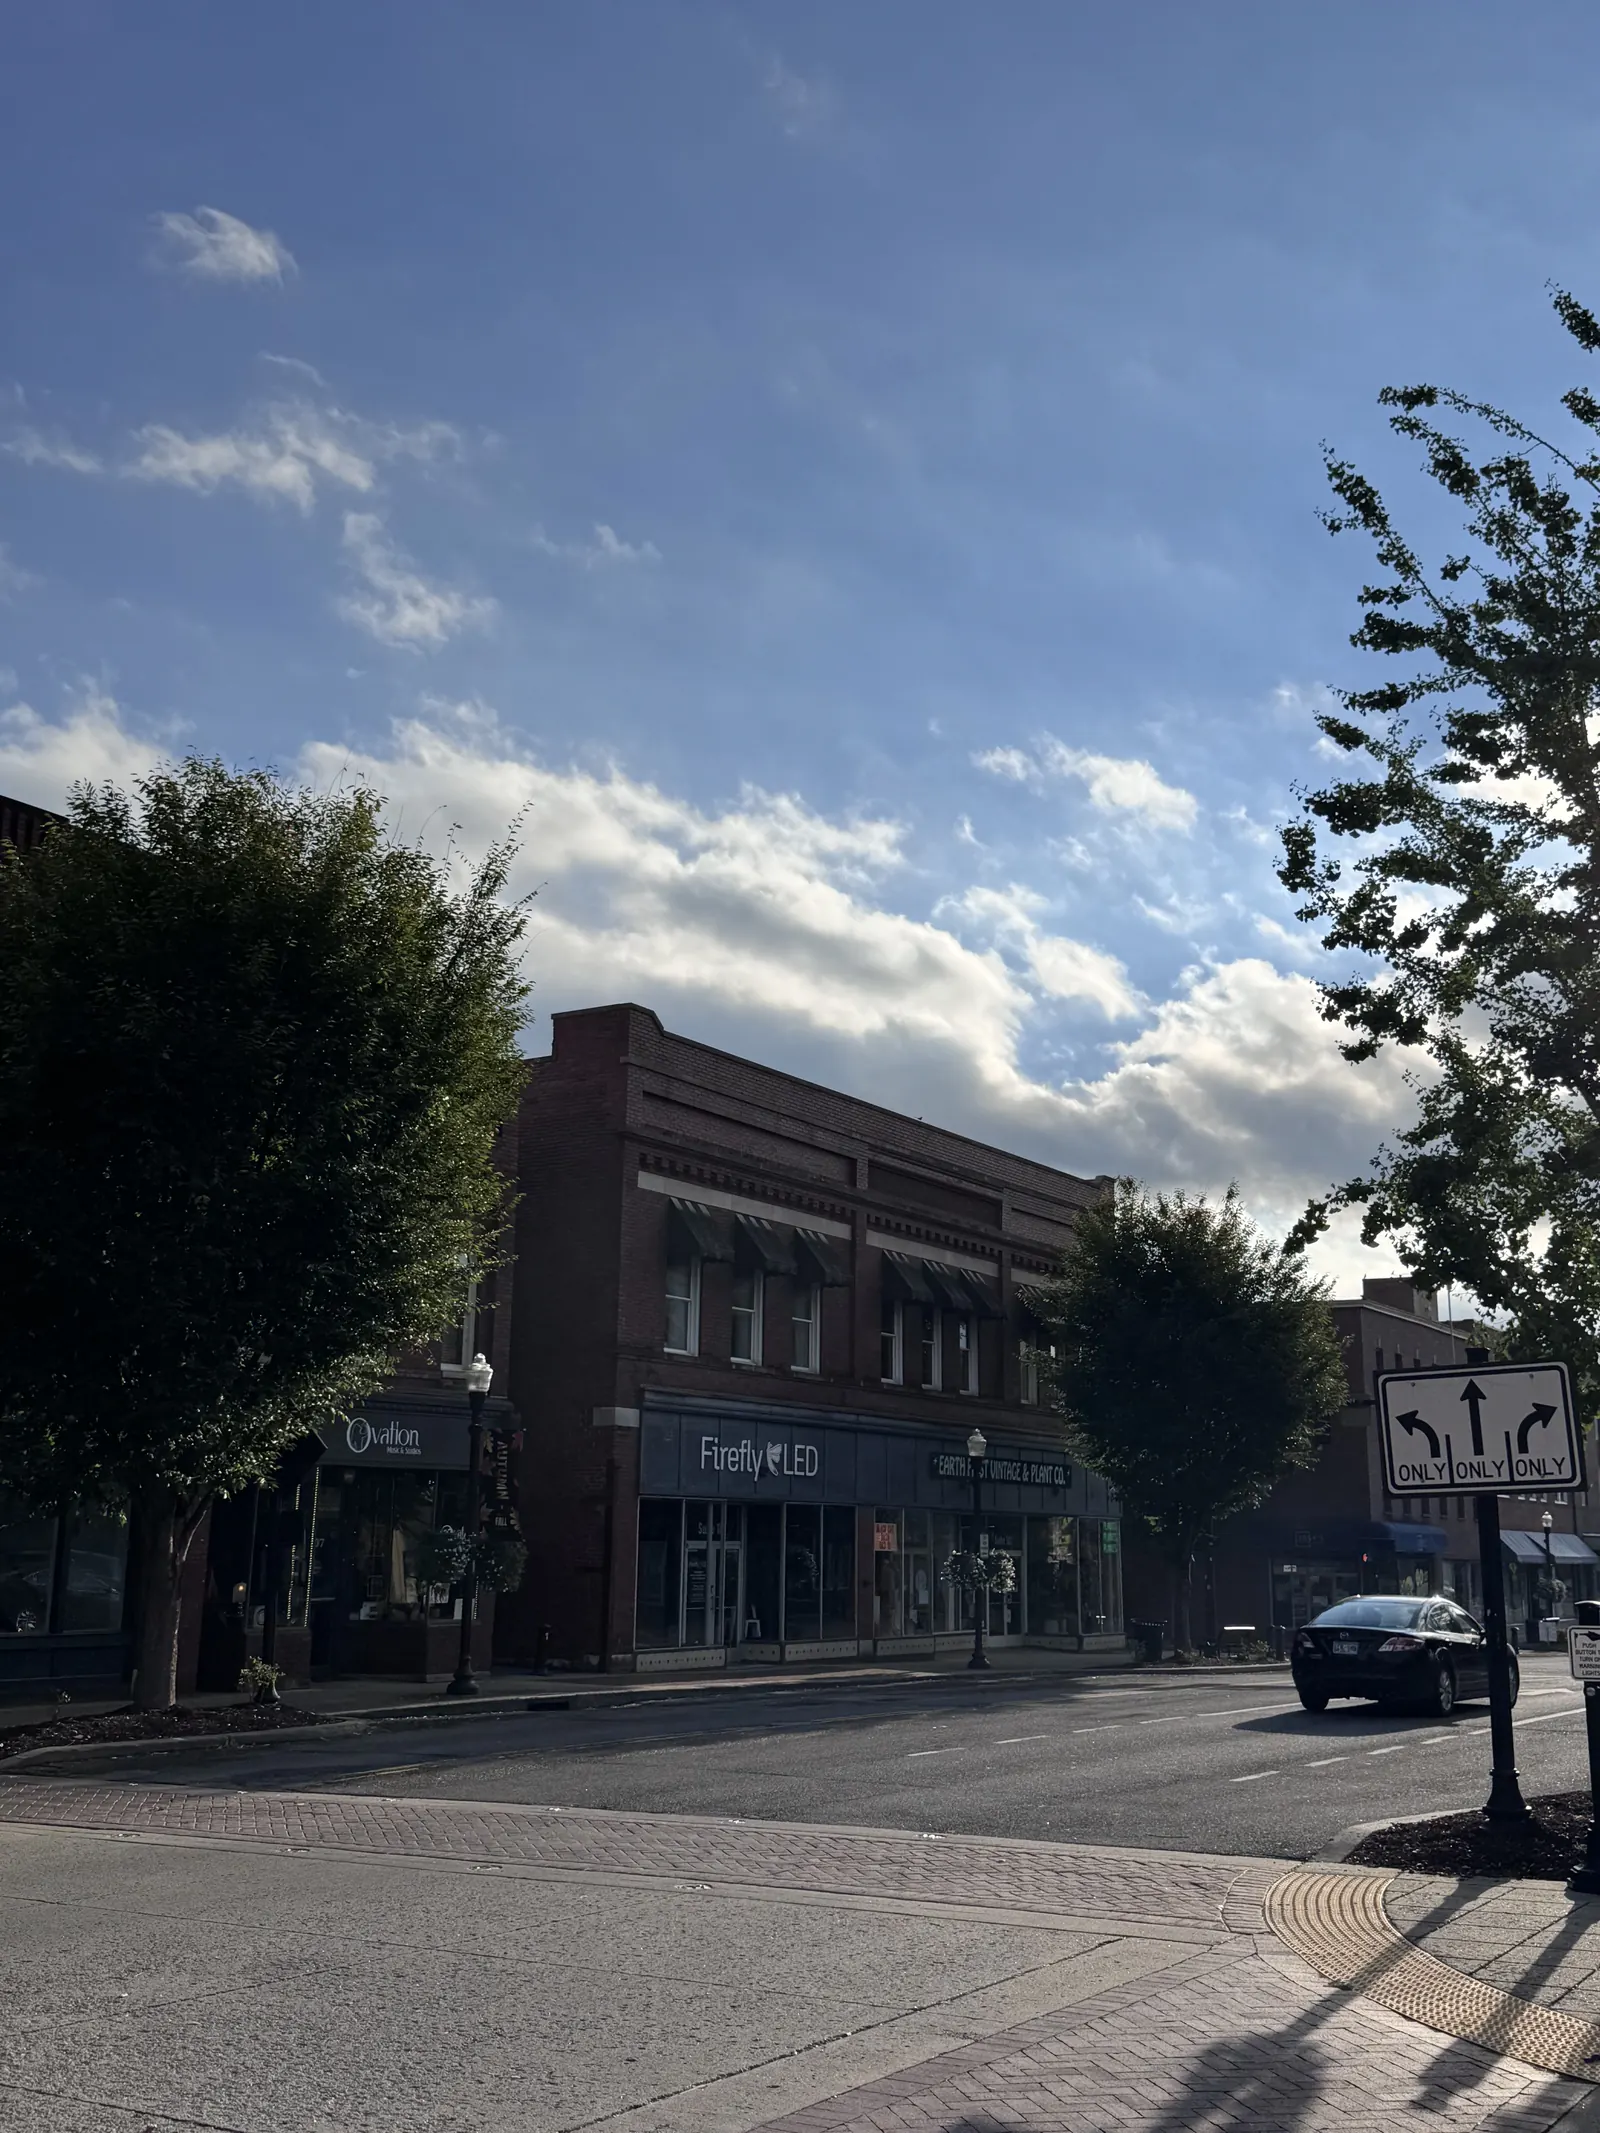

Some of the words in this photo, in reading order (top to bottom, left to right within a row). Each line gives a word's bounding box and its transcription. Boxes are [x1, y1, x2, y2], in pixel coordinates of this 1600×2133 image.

[346, 1417, 420, 1453] Ovation
[496, 1440, 510, 1500] AUTUMN
[700, 1436, 763, 1482] Firefly
[783, 1443, 818, 1476] LED
[939, 1455, 966, 1477] EARTH
[990, 1459, 1021, 1482] VINTAGE
[1022, 1463, 1030, 1482] &
[1030, 1464, 1053, 1484] PLANT
[1054, 1466, 1066, 1485] CO.
[1399, 1463, 1446, 1481] ONLY
[1456, 1460, 1504, 1479] ONLY
[1515, 1457, 1565, 1477] ONLY
